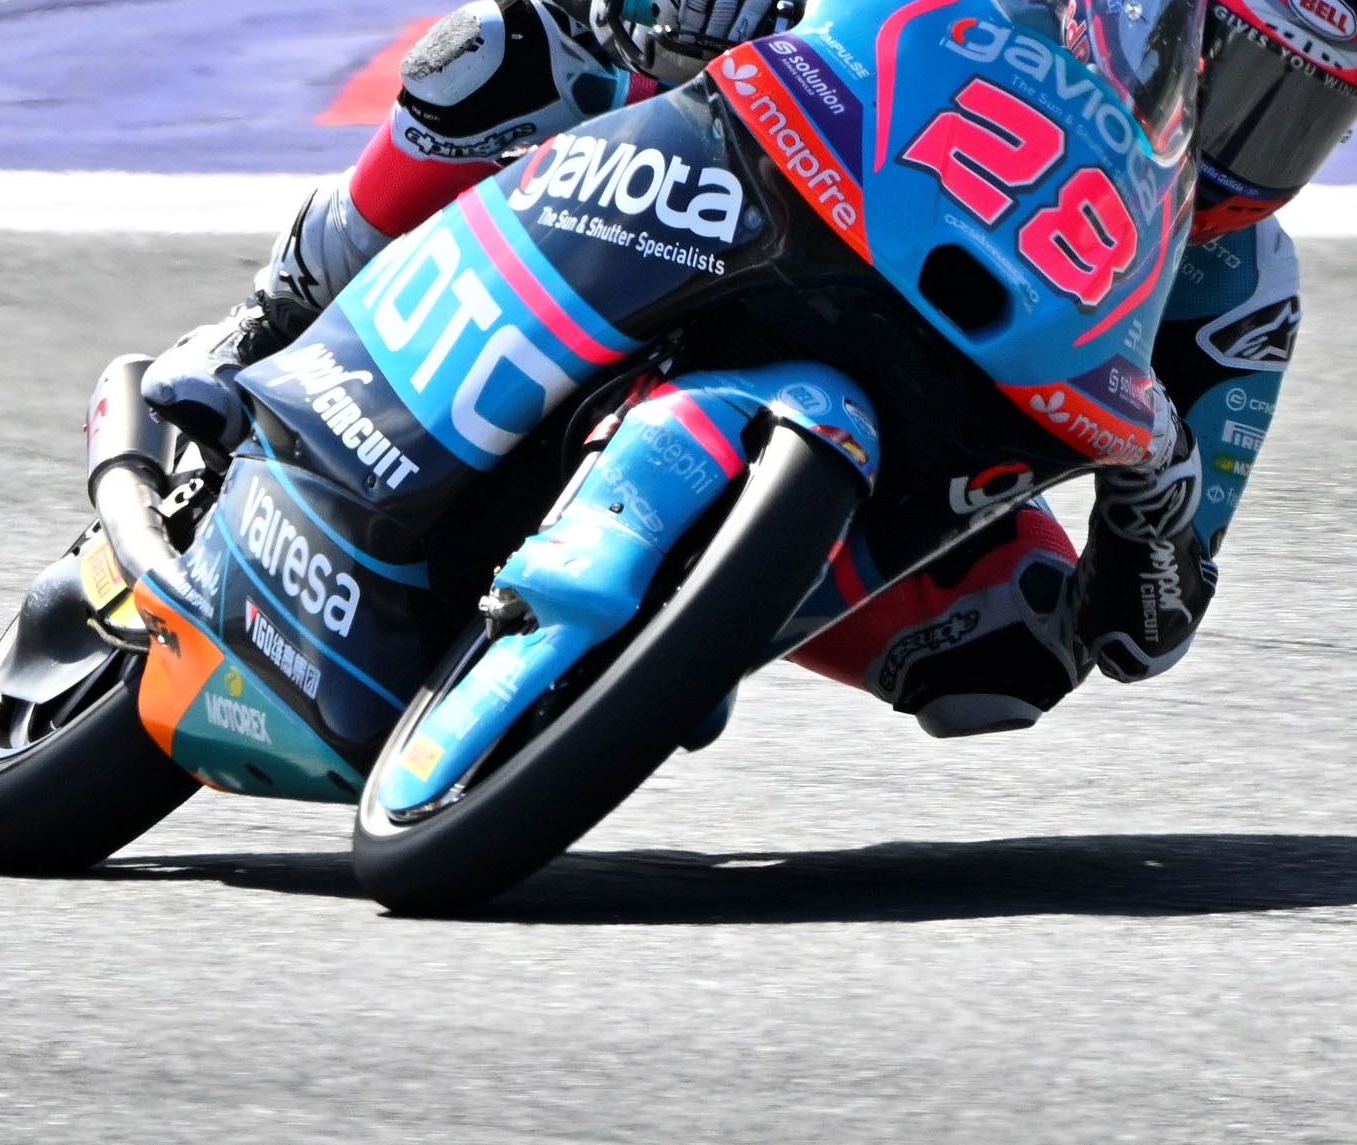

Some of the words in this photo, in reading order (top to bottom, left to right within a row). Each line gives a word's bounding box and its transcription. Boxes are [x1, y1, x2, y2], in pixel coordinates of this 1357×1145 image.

[788, 54, 845, 115] solunion
[1213, 5, 1270, 49] GIVES
[1279, 48, 1318, 77] YOU
[507, 133, 744, 244] gaviota
[748, 94, 858, 232] mapfre
[898, 75, 1141, 310] 28
[537, 206, 558, 227] The
[555, 209, 577, 231] Sun
[575, 213, 586, 234] &
[585, 216, 635, 248] Shutter
[635, 232, 726, 276] Specialists
[312, 386, 420, 490] CIRCUIT
[204, 690, 273, 746] MOTOREX
